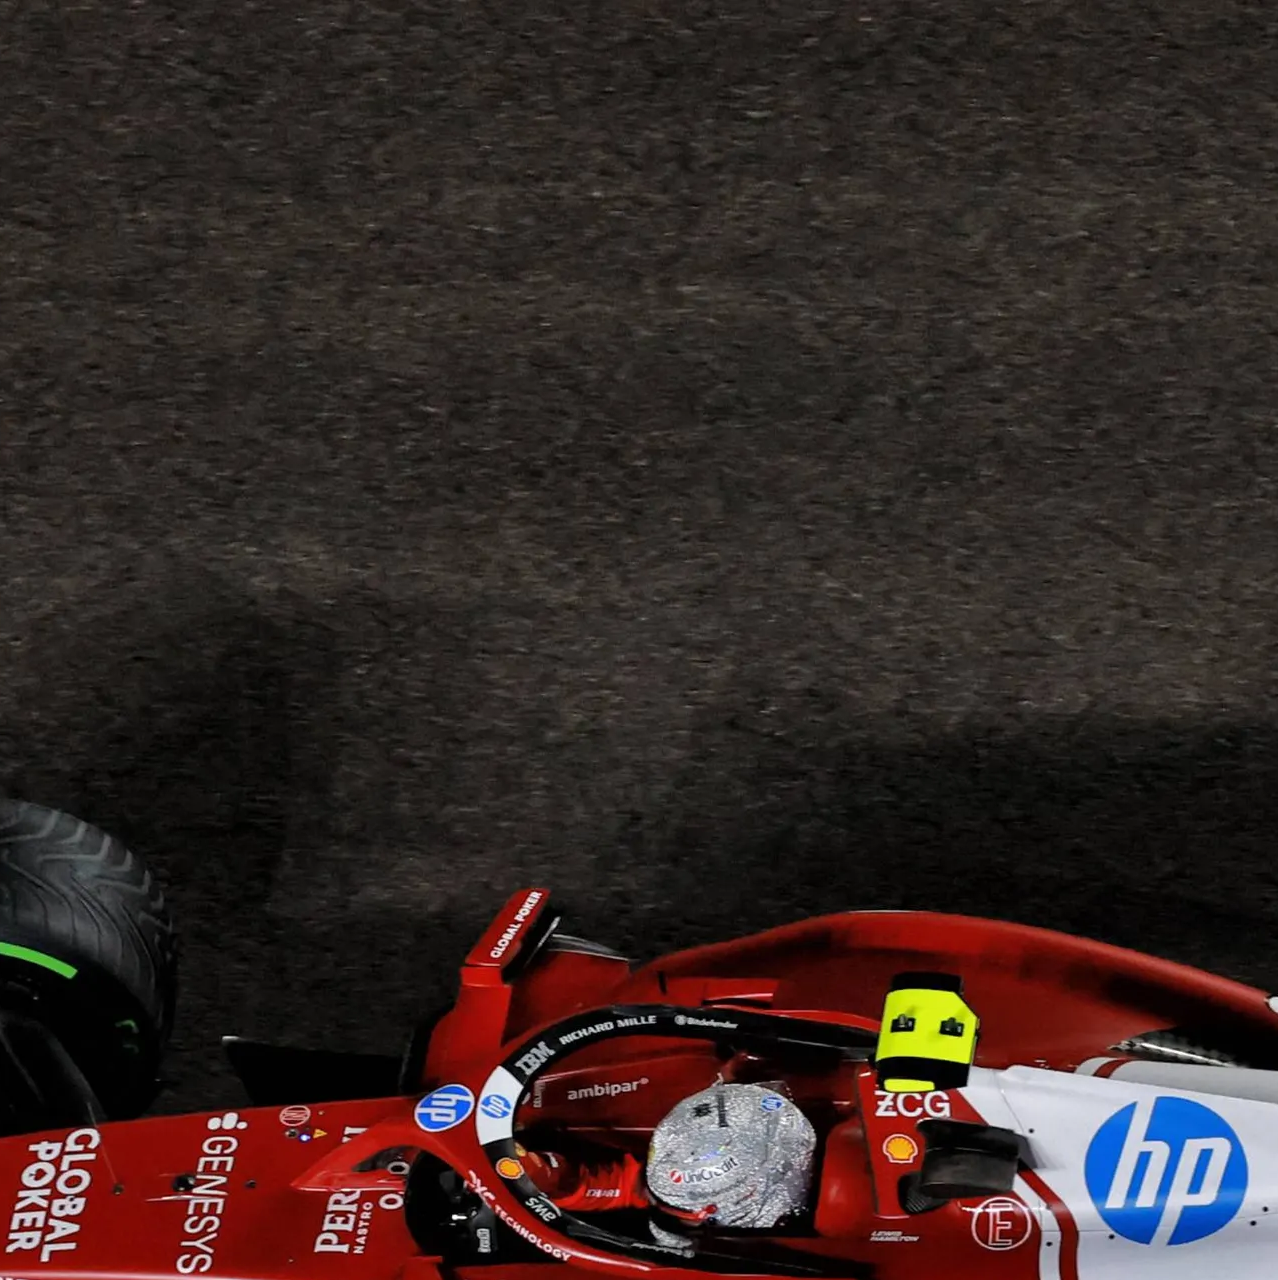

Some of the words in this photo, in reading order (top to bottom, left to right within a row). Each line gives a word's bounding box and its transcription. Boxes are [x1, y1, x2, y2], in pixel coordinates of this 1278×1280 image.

[490, 919, 523, 959] GLOBAL
[516, 891, 543, 922] POKER
[558, 1021, 614, 1045] RICHARD
[617, 1015, 657, 1028] MILLE
[515, 1041, 556, 1076] IBM
[416, 1088, 474, 1127] hp
[481, 1095, 511, 1118] hp
[6, 1140, 62, 1253] POKER
[39, 1128, 100, 1262] GLOBAL
[1101, 1096, 1235, 1246] hp
[176, 1136, 239, 1274] GENESYS
[353, 1202, 374, 1254] NASTRO
[525, 1197, 557, 1222] aws
[495, 1204, 571, 1261] TECHNOLOGY
